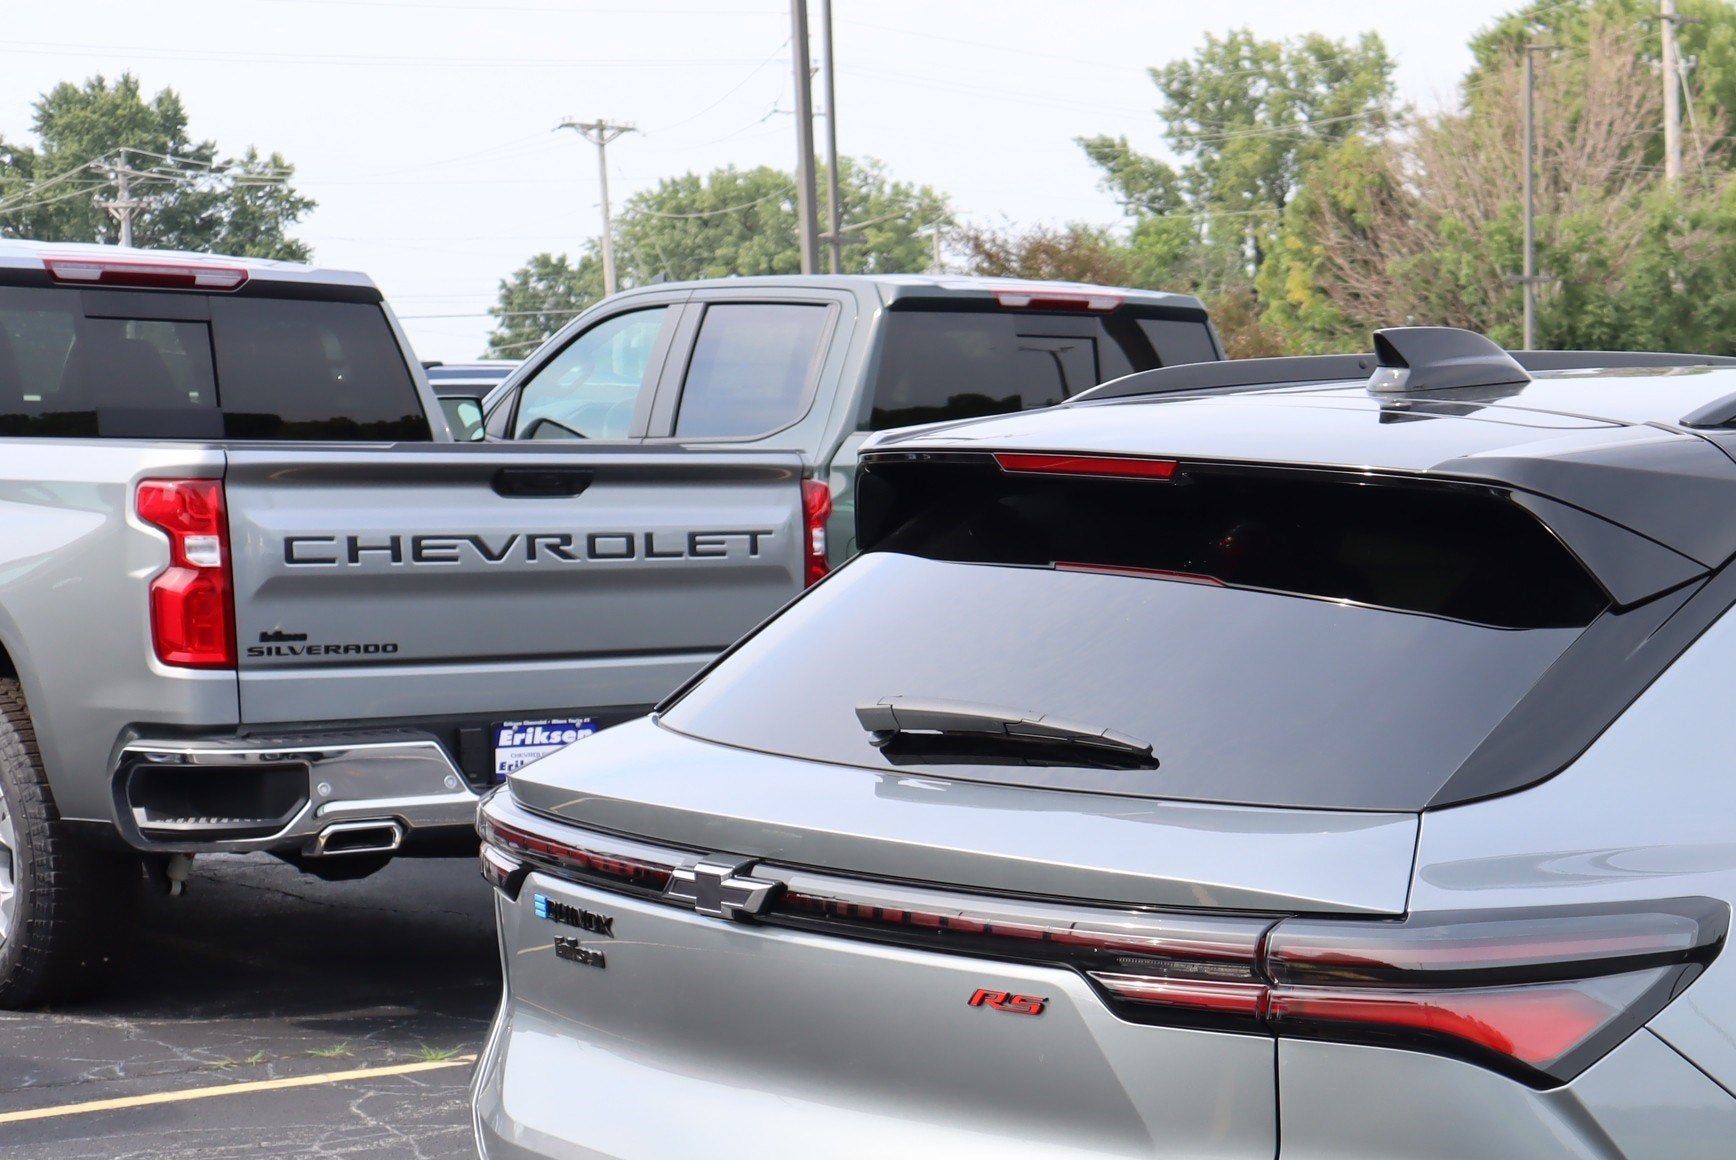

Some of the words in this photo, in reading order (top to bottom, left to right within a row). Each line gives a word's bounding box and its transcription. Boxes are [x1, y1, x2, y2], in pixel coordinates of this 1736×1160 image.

[283, 529, 775, 566] CHEVROLET
[246, 643, 399, 657] SILVERADO
[967, 987, 1050, 1016] RS
